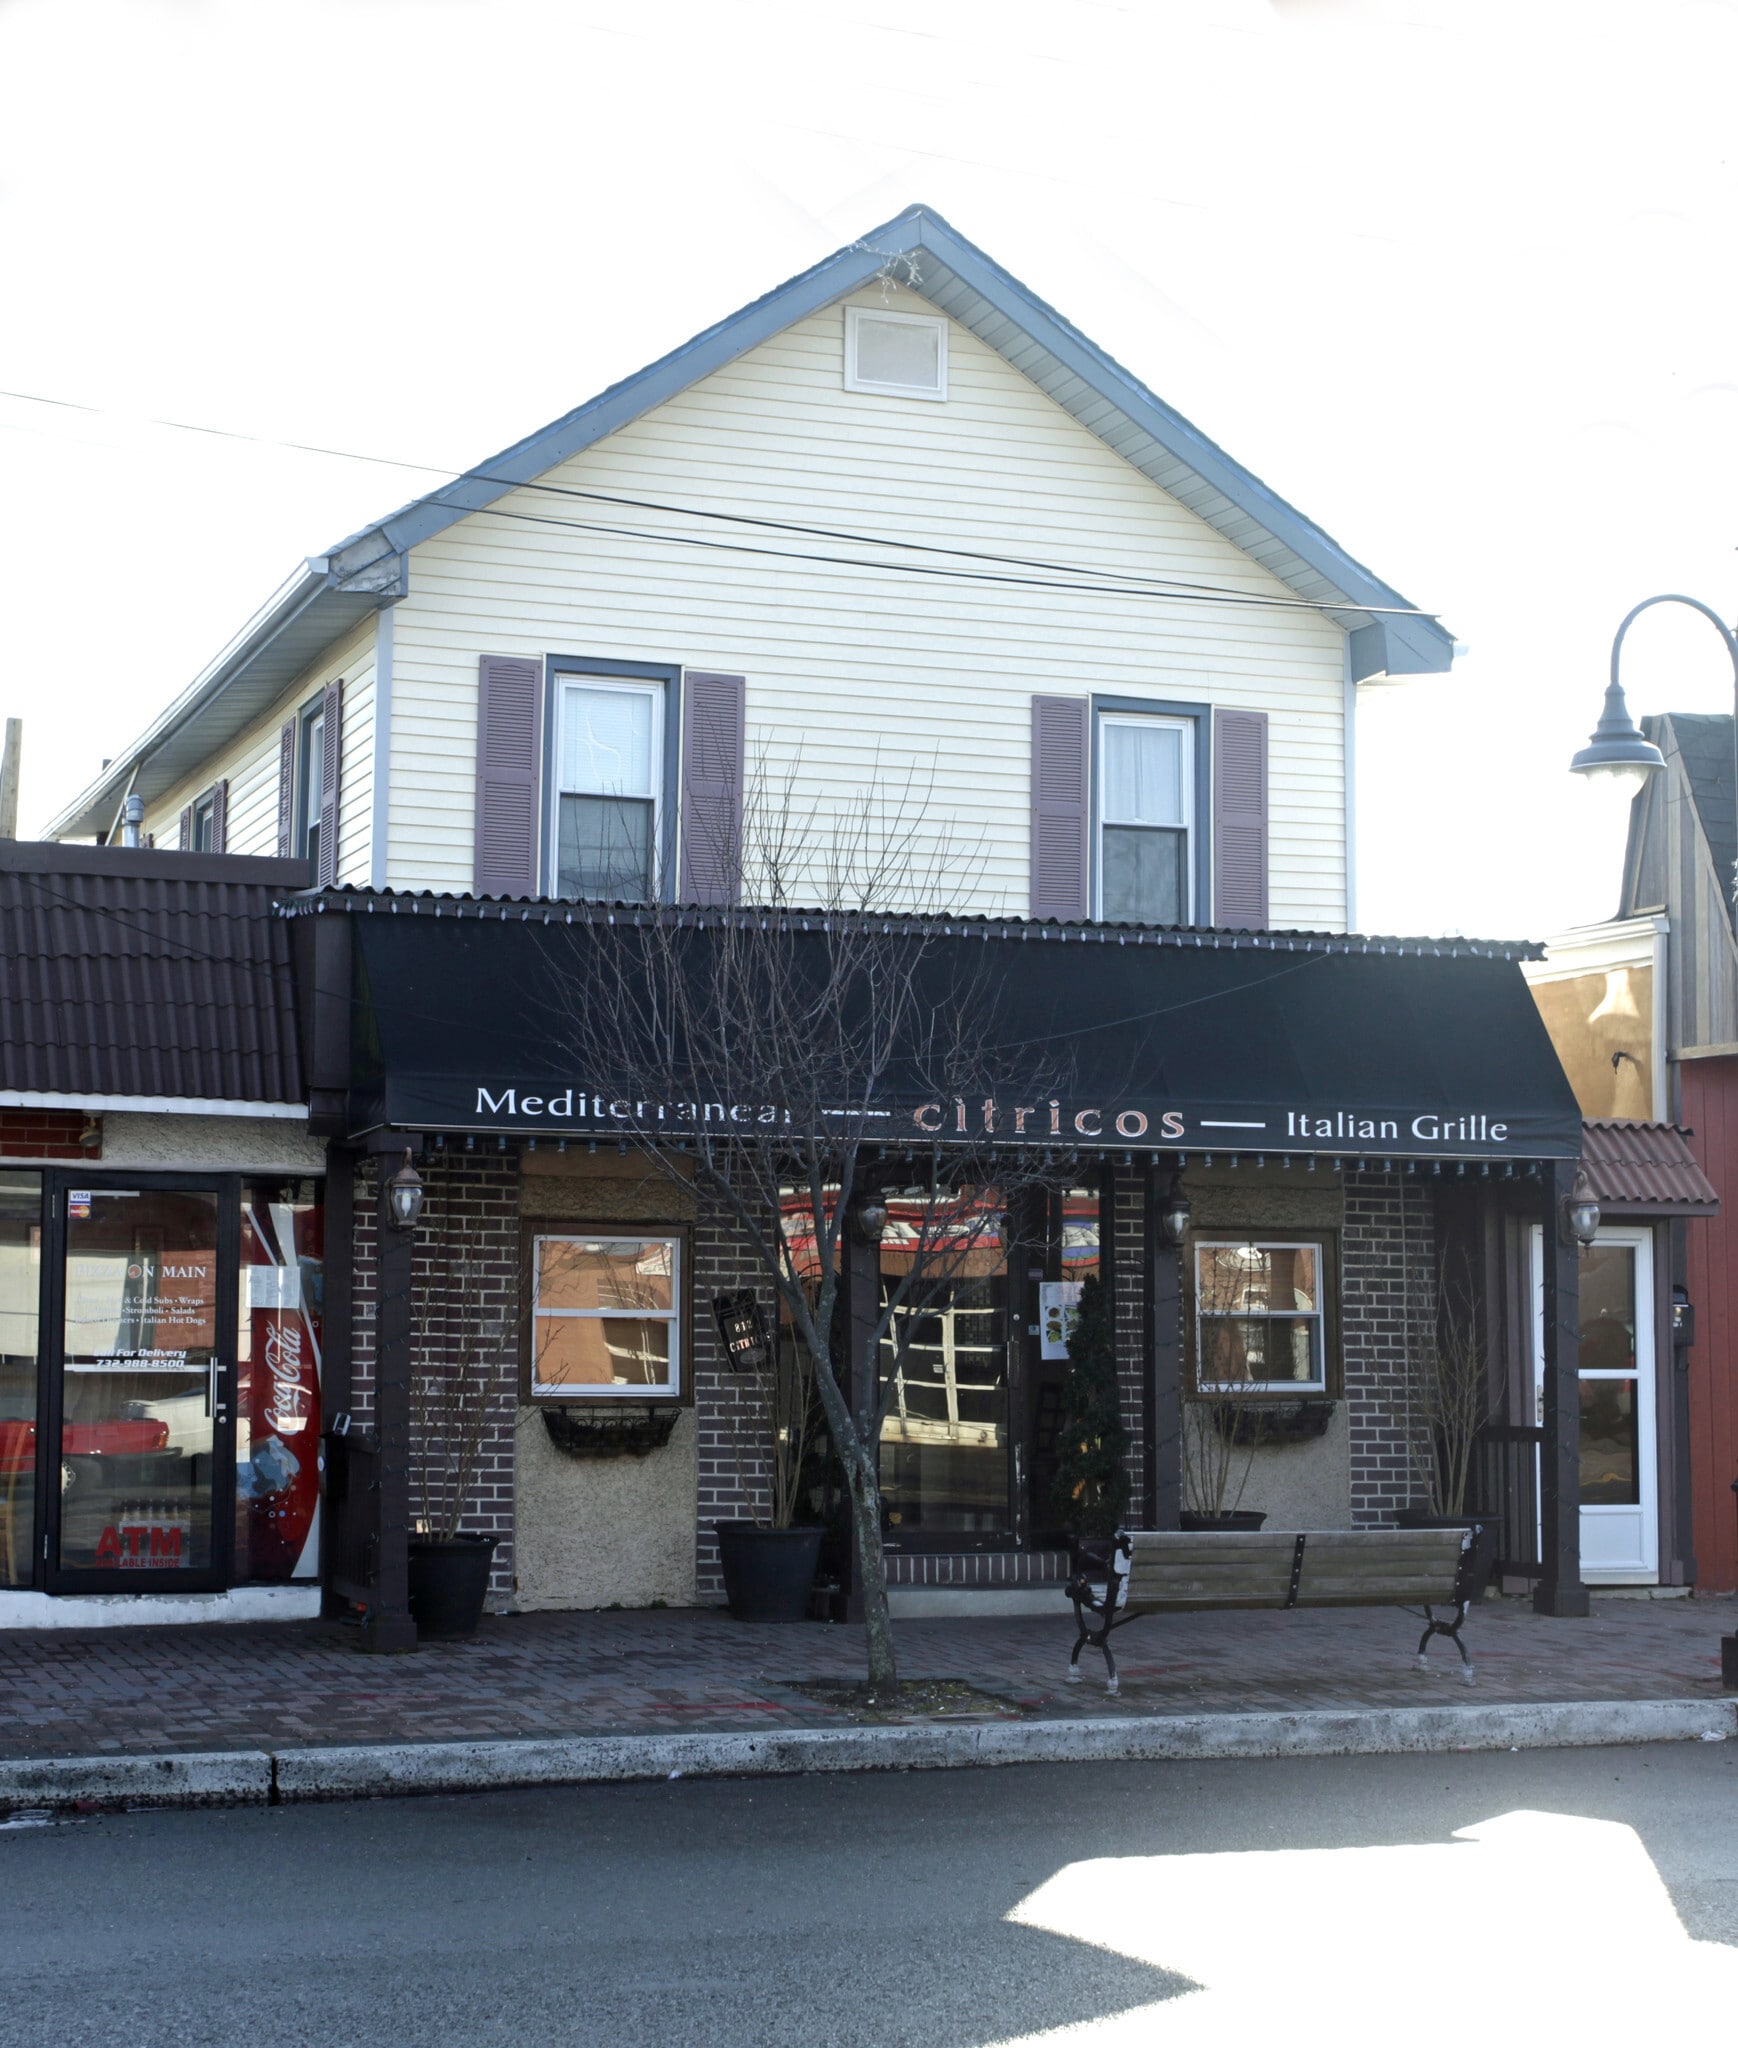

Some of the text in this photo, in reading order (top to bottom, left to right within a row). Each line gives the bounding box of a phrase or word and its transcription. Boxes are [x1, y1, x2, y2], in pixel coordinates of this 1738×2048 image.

[1287, 1111, 1398, 1139] Italian
[1411, 1114, 1508, 1141] Grille
[72, 1192, 89, 1200] VISA
[76, 1264, 207, 1279] PIZZA ON MAIN
[133, 1296, 152, 1304] Cold
[153, 1296, 174, 1304] Subs
[178, 1296, 205, 1306] Wraps
[125, 1306, 164, 1314] Stromboli
[170, 1306, 195, 1314] Salads
[141, 1316, 166, 1324] Italian
[168, 1316, 184, 1324] Hot
[185, 1316, 206, 1325] Dogs
[116, 1348, 138, 1357] For
[138, 1348, 187, 1359] Delivery
[96, 1359, 185, 1368] 732-988-8500
[95, 1526, 182, 1557] ATM
[148, 1557, 180, 1569] INSIDE
